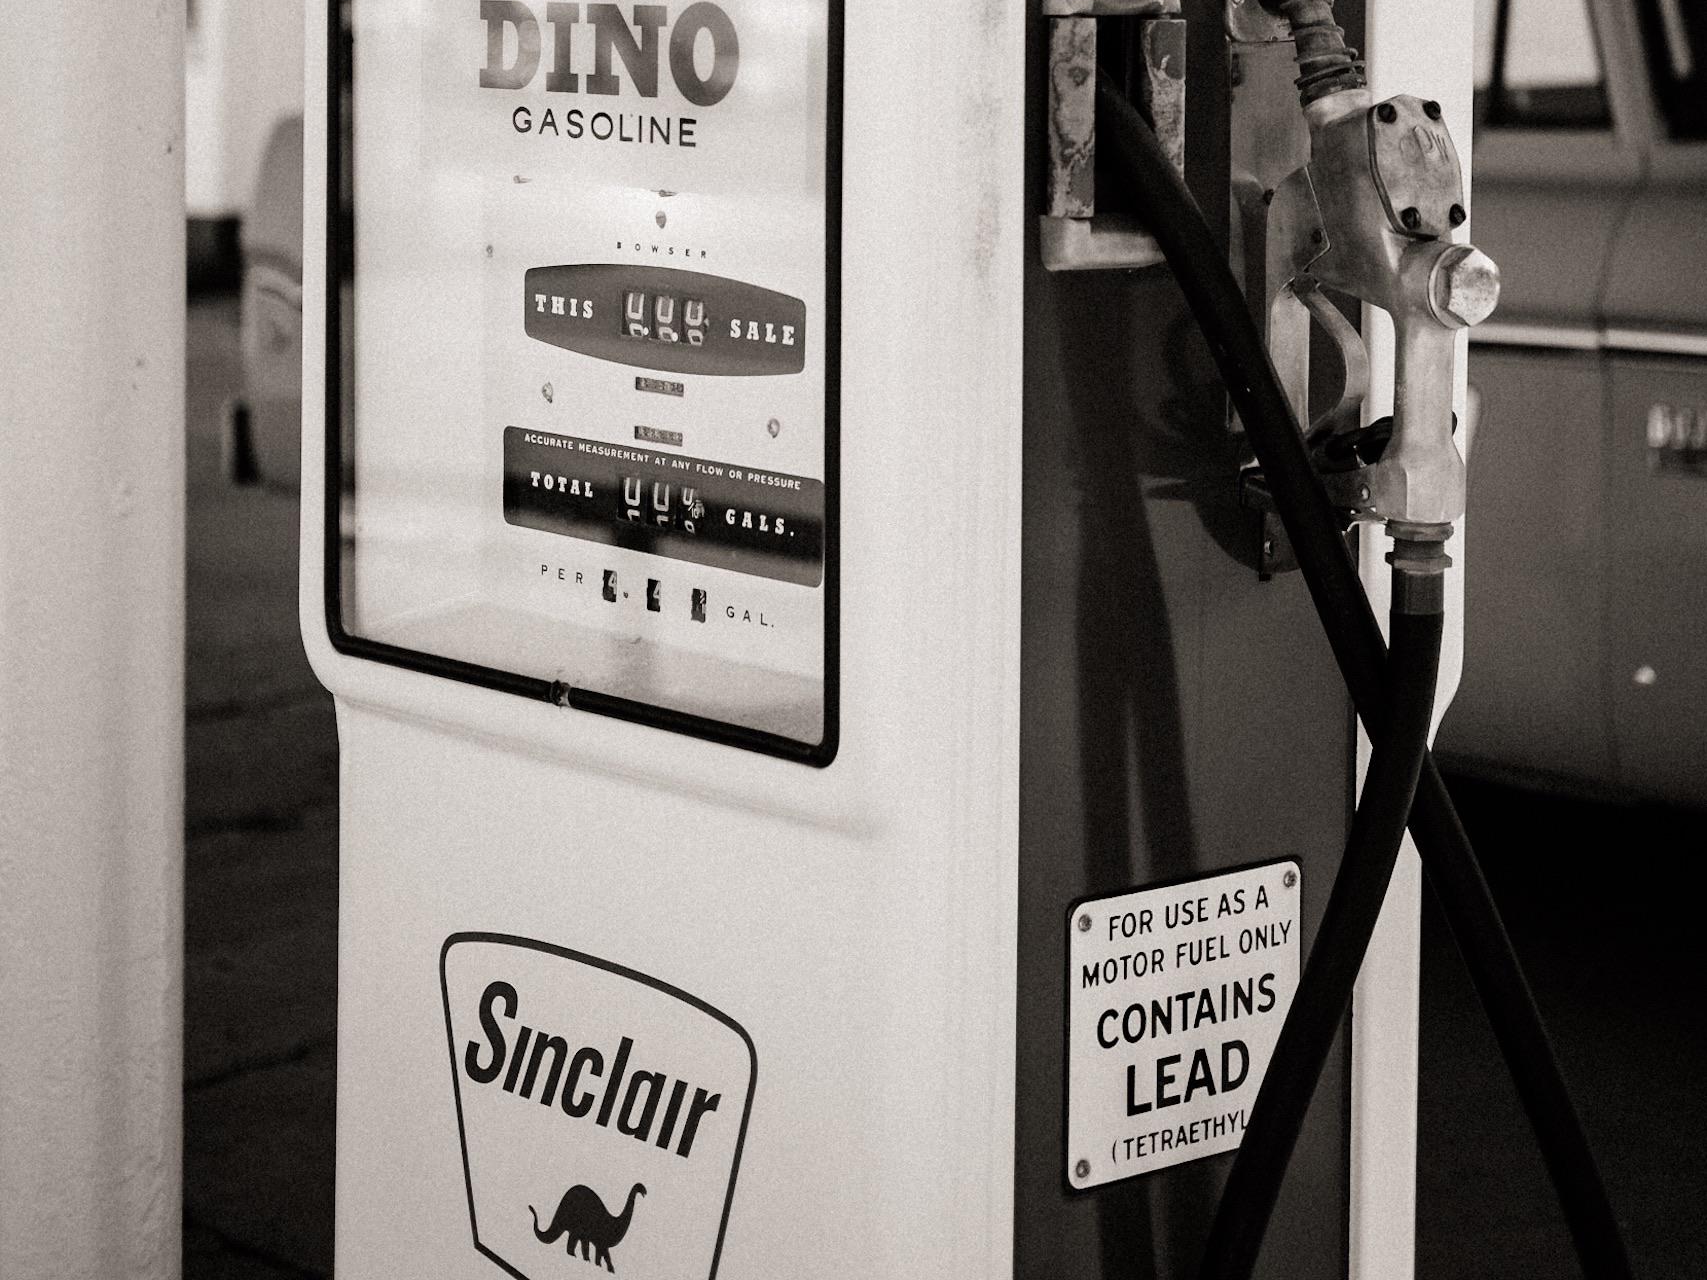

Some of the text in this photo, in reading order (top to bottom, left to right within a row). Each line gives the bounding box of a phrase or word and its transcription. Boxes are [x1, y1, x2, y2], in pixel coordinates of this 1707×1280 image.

[479, 0, 739, 107] DINO
[512, 106, 698, 148] GASOLINE
[616, 241, 707, 259] BOWSER
[535, 293, 594, 319] THIS
[729, 318, 795, 346] SALE
[524, 433, 802, 490] ACCURATE MEASUREMENT AT ANY FLOW OR PRESSURE
[530, 471, 795, 537] TOTAL GALS.
[540, 564, 584, 585] PER
[726, 605, 775, 628] GAL.
[1108, 884, 1269, 942] FOR USE AS A
[1082, 919, 1292, 990] MOTOR FUEL ONLY
[1096, 972, 1276, 1050] CONTAINS
[464, 980, 722, 1159] Sinclair
[1126, 1039, 1250, 1117] LEAD
